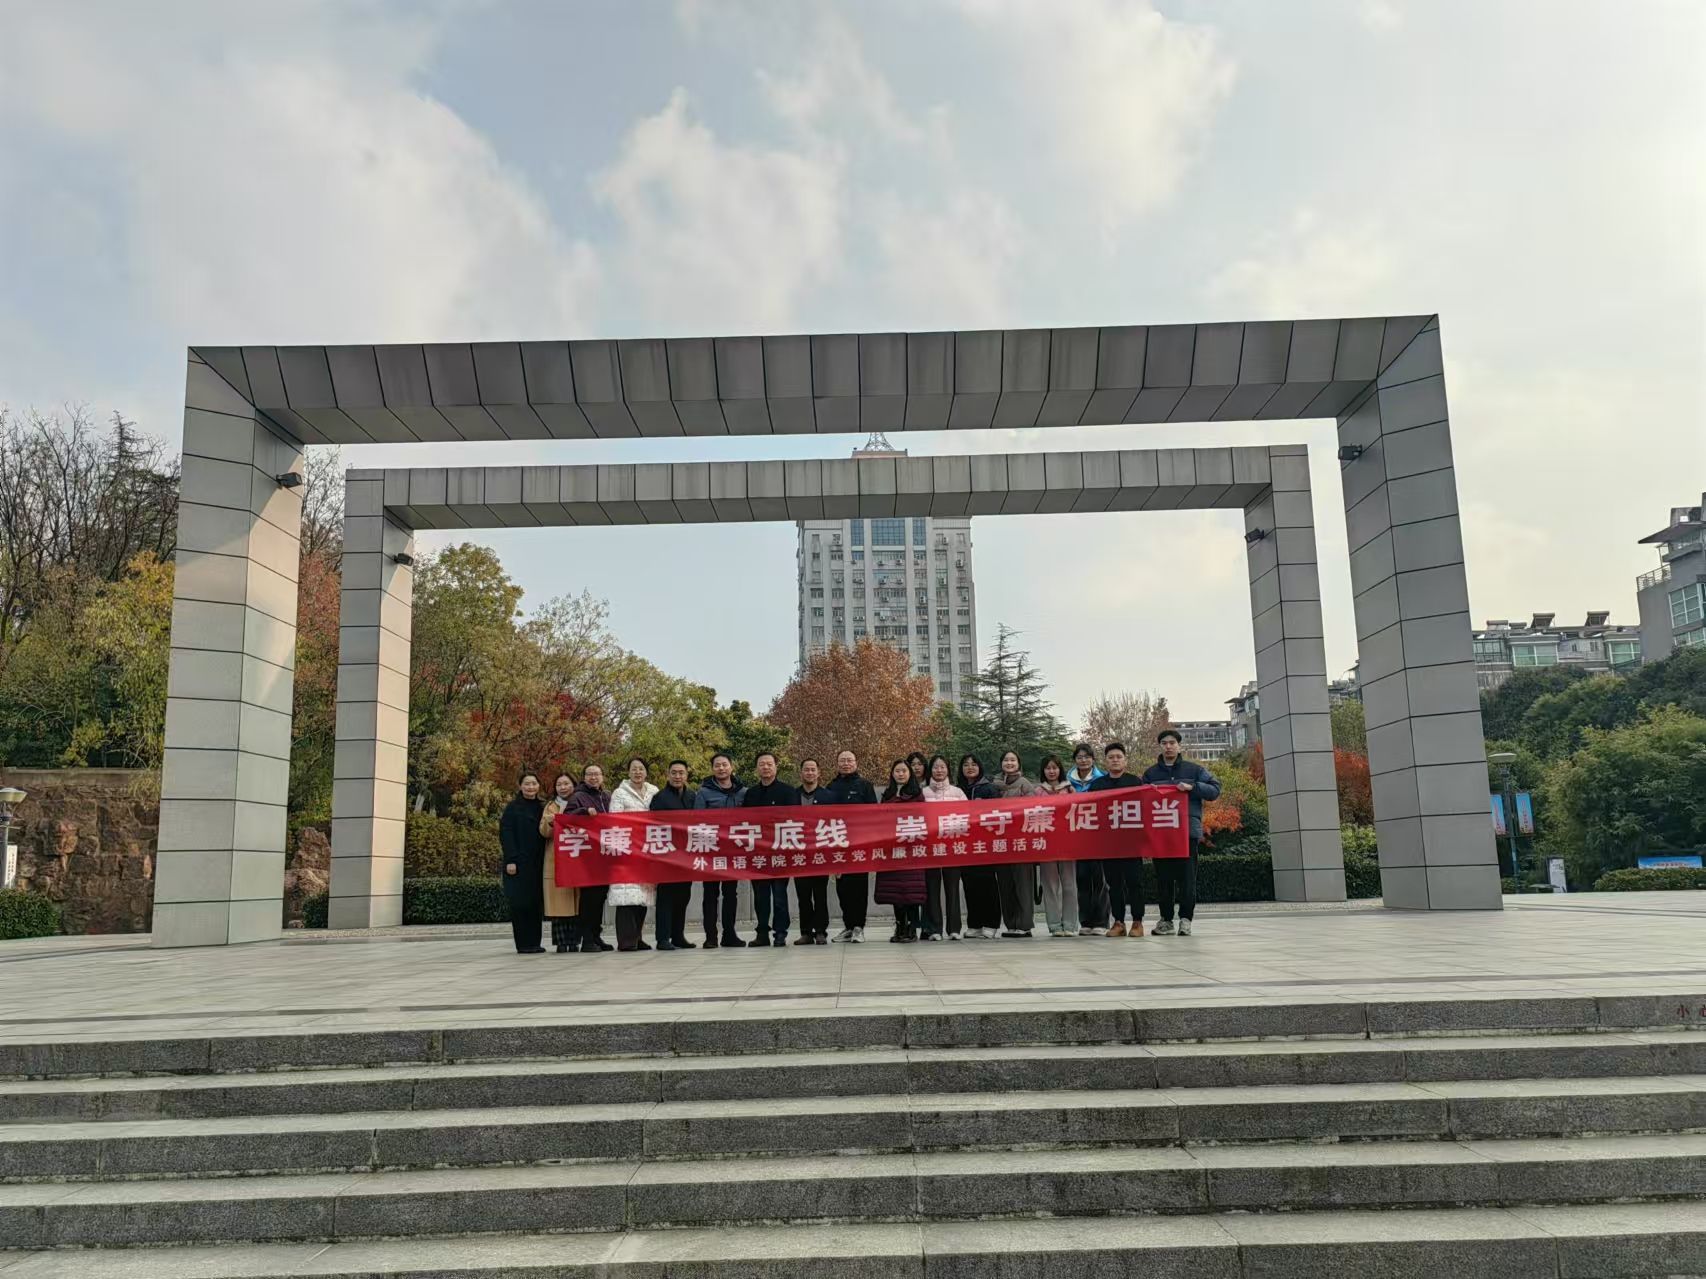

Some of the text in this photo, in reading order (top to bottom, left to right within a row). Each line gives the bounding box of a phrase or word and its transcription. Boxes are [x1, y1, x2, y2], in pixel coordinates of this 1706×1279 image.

[558, 798, 1181, 858] 学廉思廉守底线 崇廉守廉促担当
[692, 836, 1047, 872] 外国语学院党总支党风廉政建设主题活动
